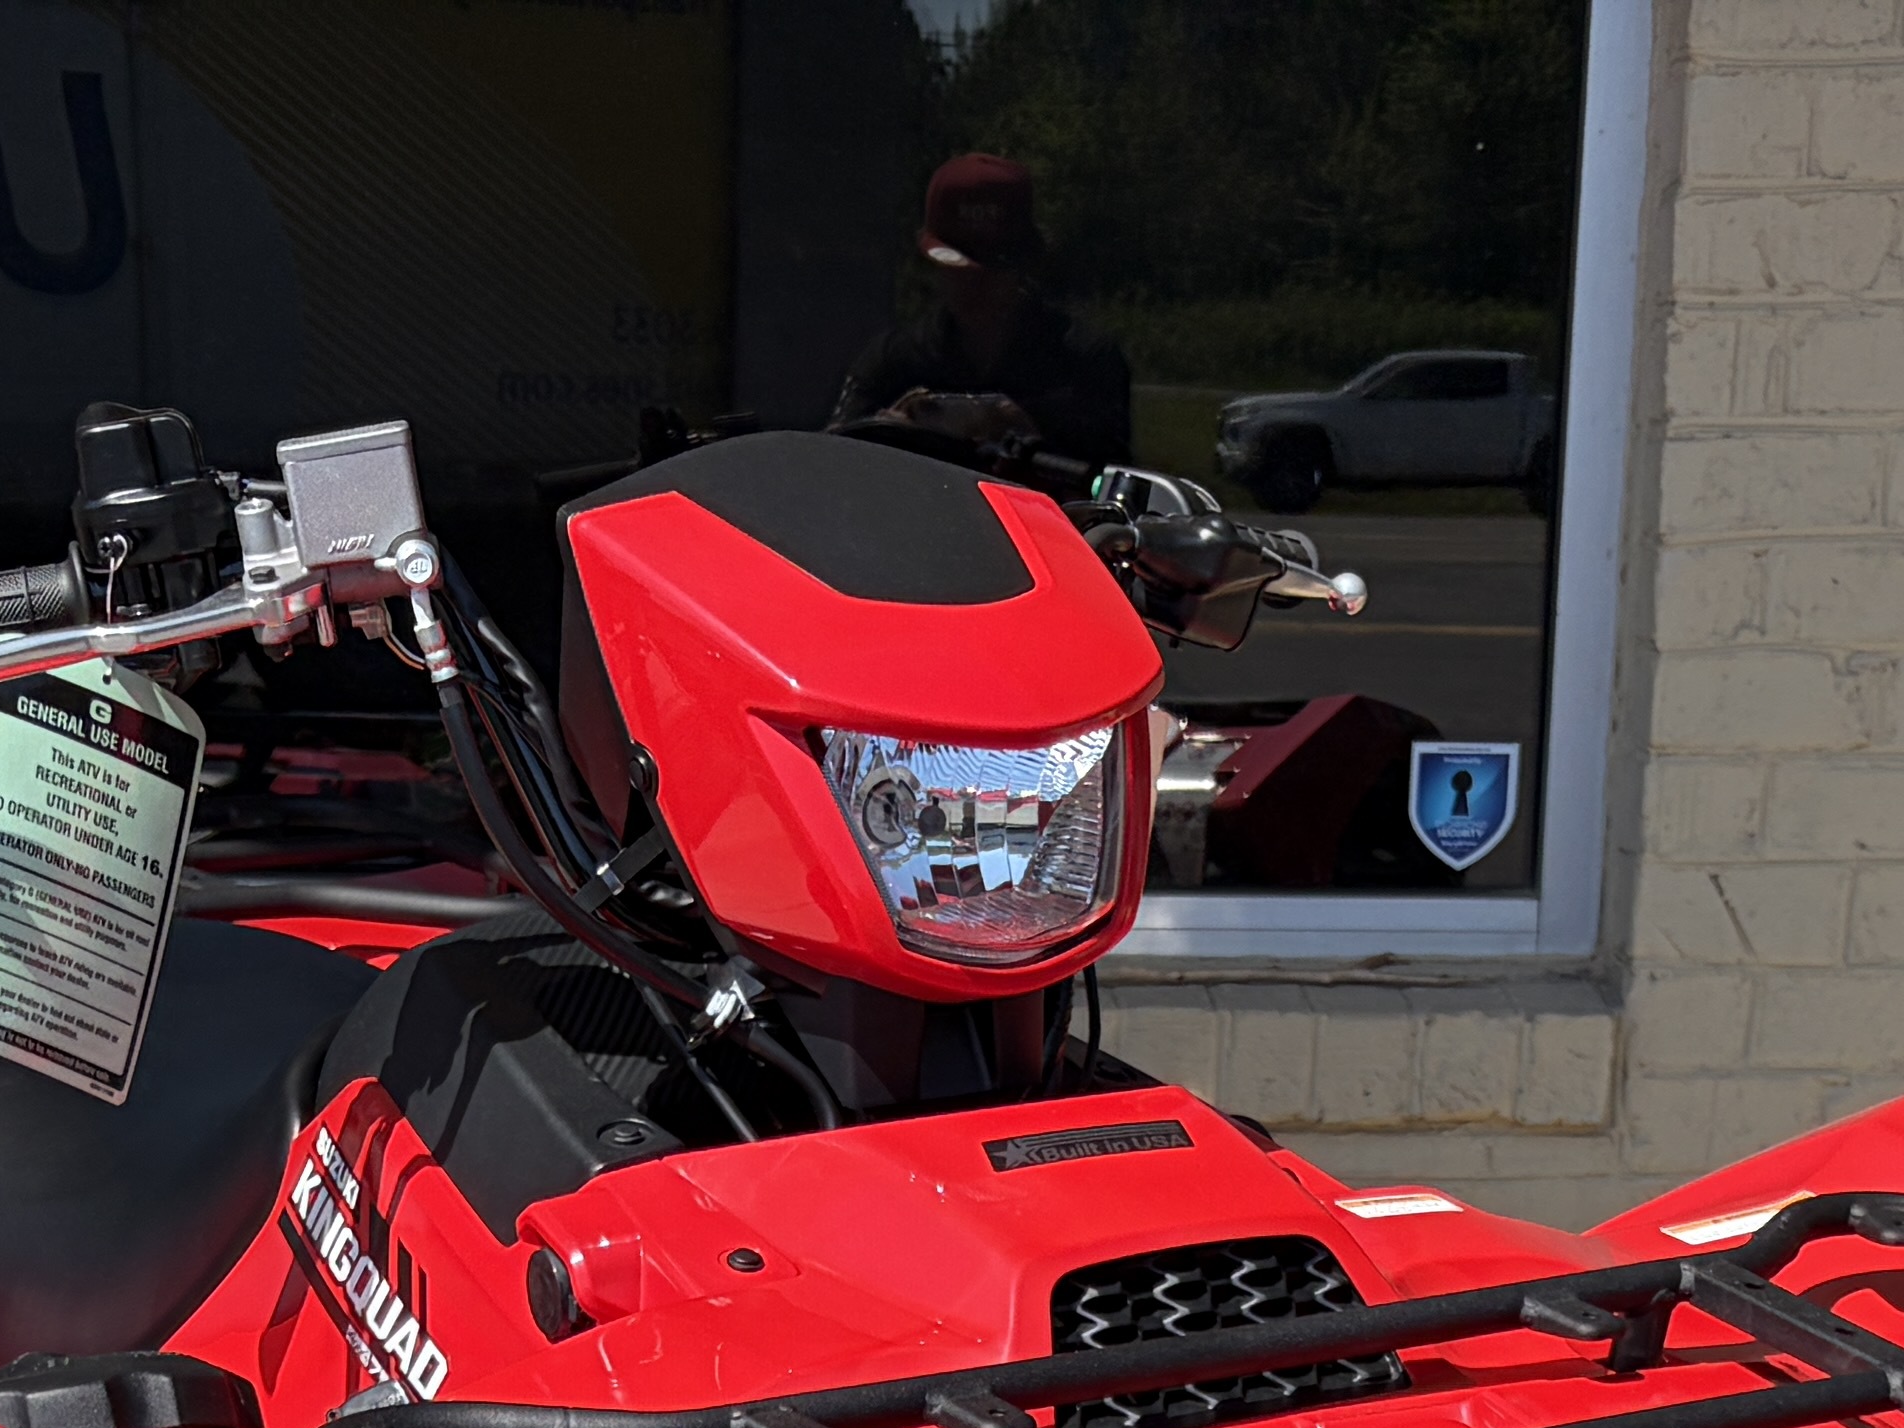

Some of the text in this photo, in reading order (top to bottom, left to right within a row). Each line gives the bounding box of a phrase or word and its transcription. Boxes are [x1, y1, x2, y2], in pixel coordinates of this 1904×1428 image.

[16, 694, 171, 774] GENERAL USE MODEL
[90, 699, 112, 724] G
[35, 764, 137, 819] RECREATIONAL or
[50, 747, 131, 793] This ATV is for
[7, 798, 71, 838] OPERATOR
[73, 826, 114, 856] UNDER
[114, 844, 138, 866] AGE
[140, 854, 165, 878] 16.
[45, 791, 120, 837] UTILITY USE,
[91, 869, 155, 908] PASSENGERS
[315, 1126, 360, 1210] SUZUKI
[1043, 1134, 1190, 1162] Built in USA
[291, 1158, 448, 1401] KINGQUAD
